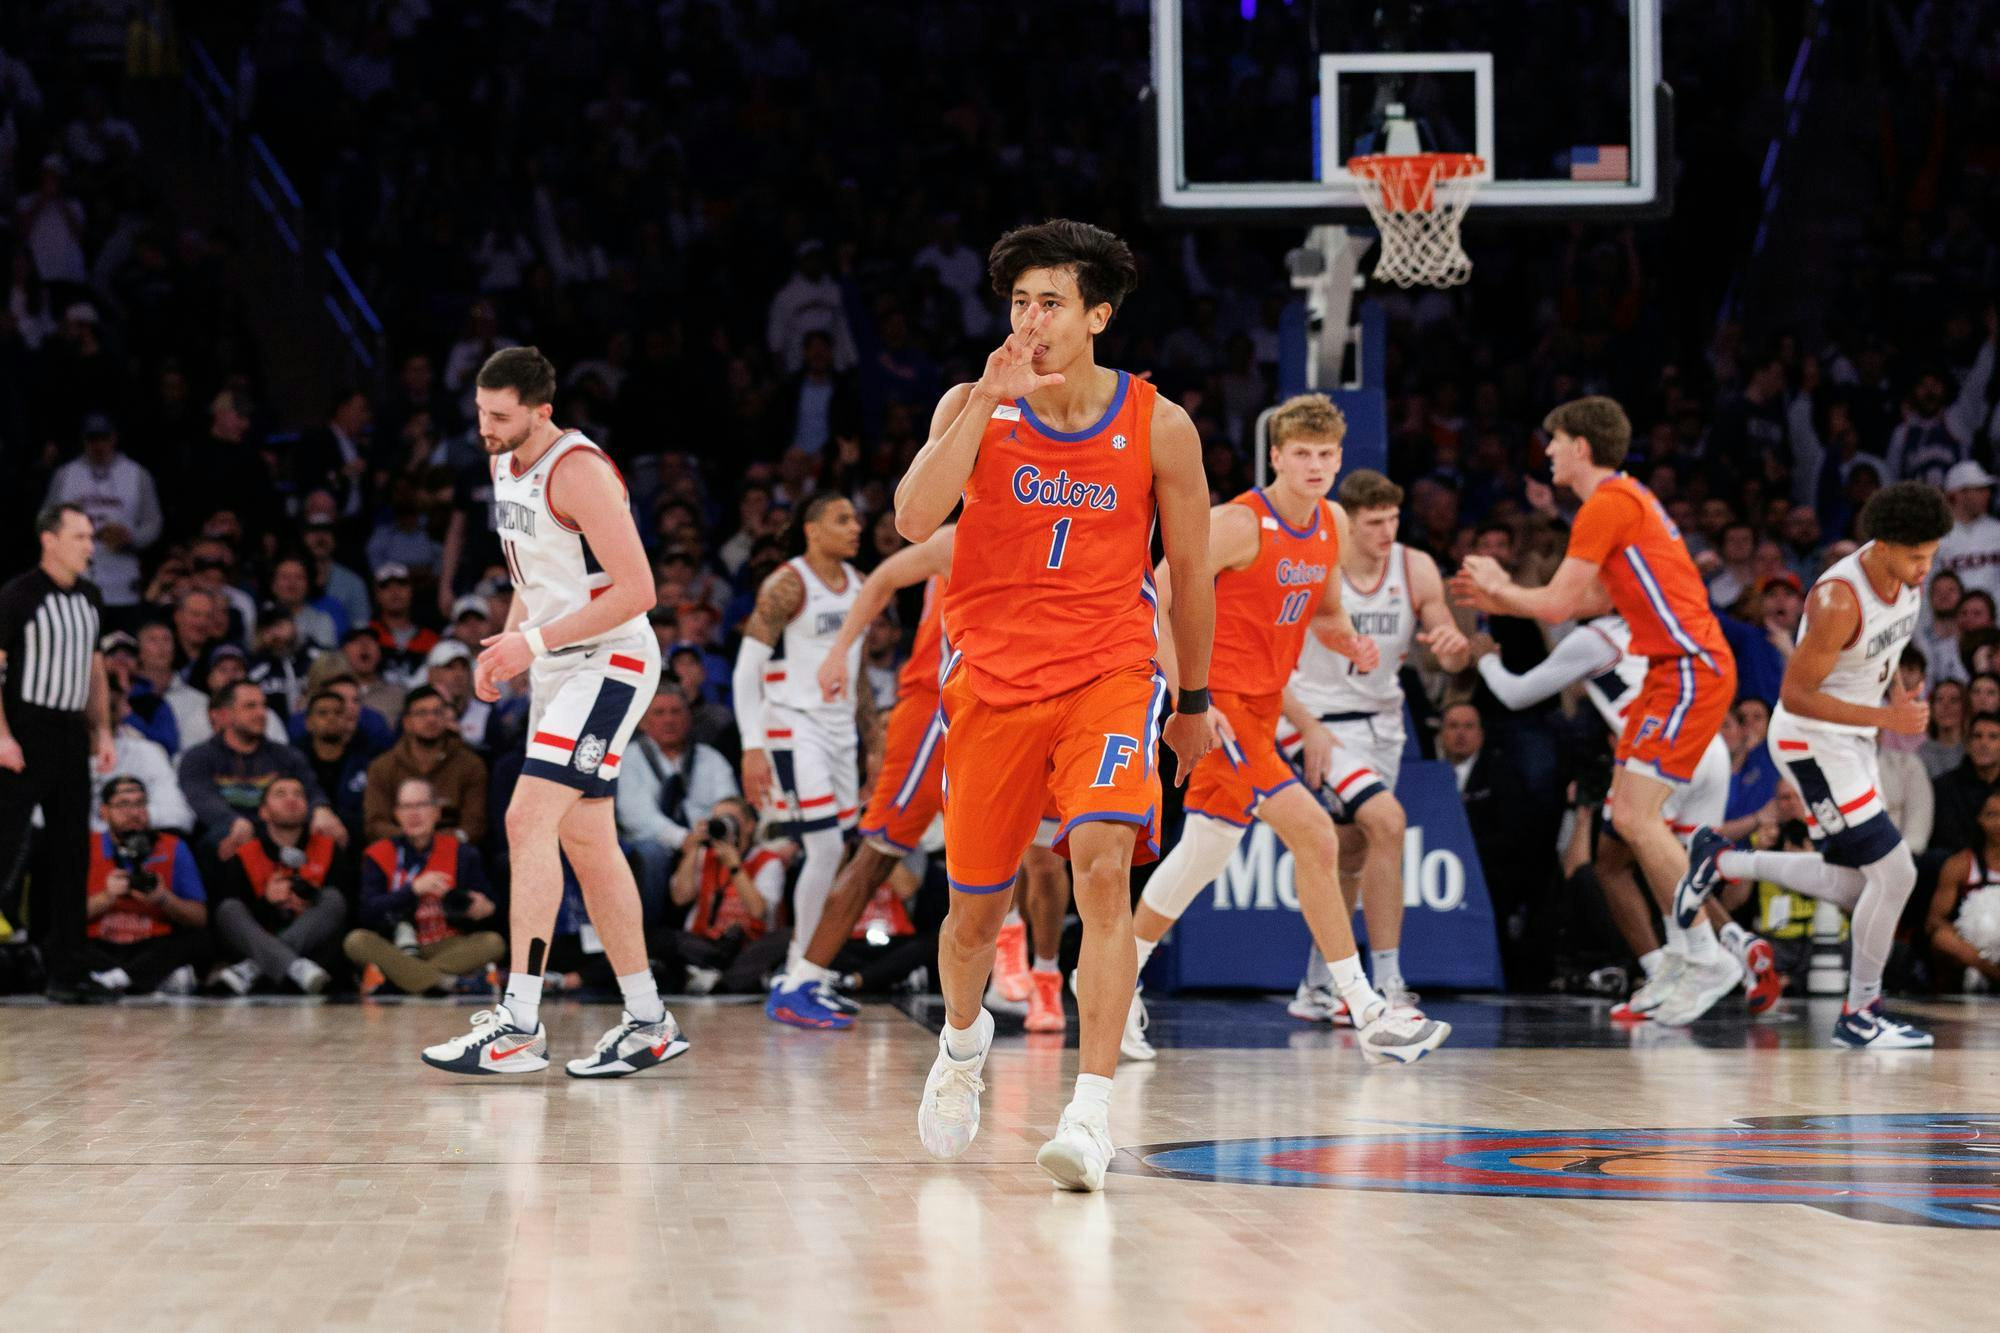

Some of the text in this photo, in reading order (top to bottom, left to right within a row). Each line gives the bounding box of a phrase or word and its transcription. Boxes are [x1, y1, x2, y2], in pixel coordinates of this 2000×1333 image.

[1012, 464, 1118, 512] Gators
[504, 539, 527, 585] 11
[1046, 516, 1073, 570] 1
[1276, 558, 1327, 587] Gators
[1275, 589, 1311, 626] 10
[1631, 713, 1663, 747] F
[1089, 733, 1140, 788] F
